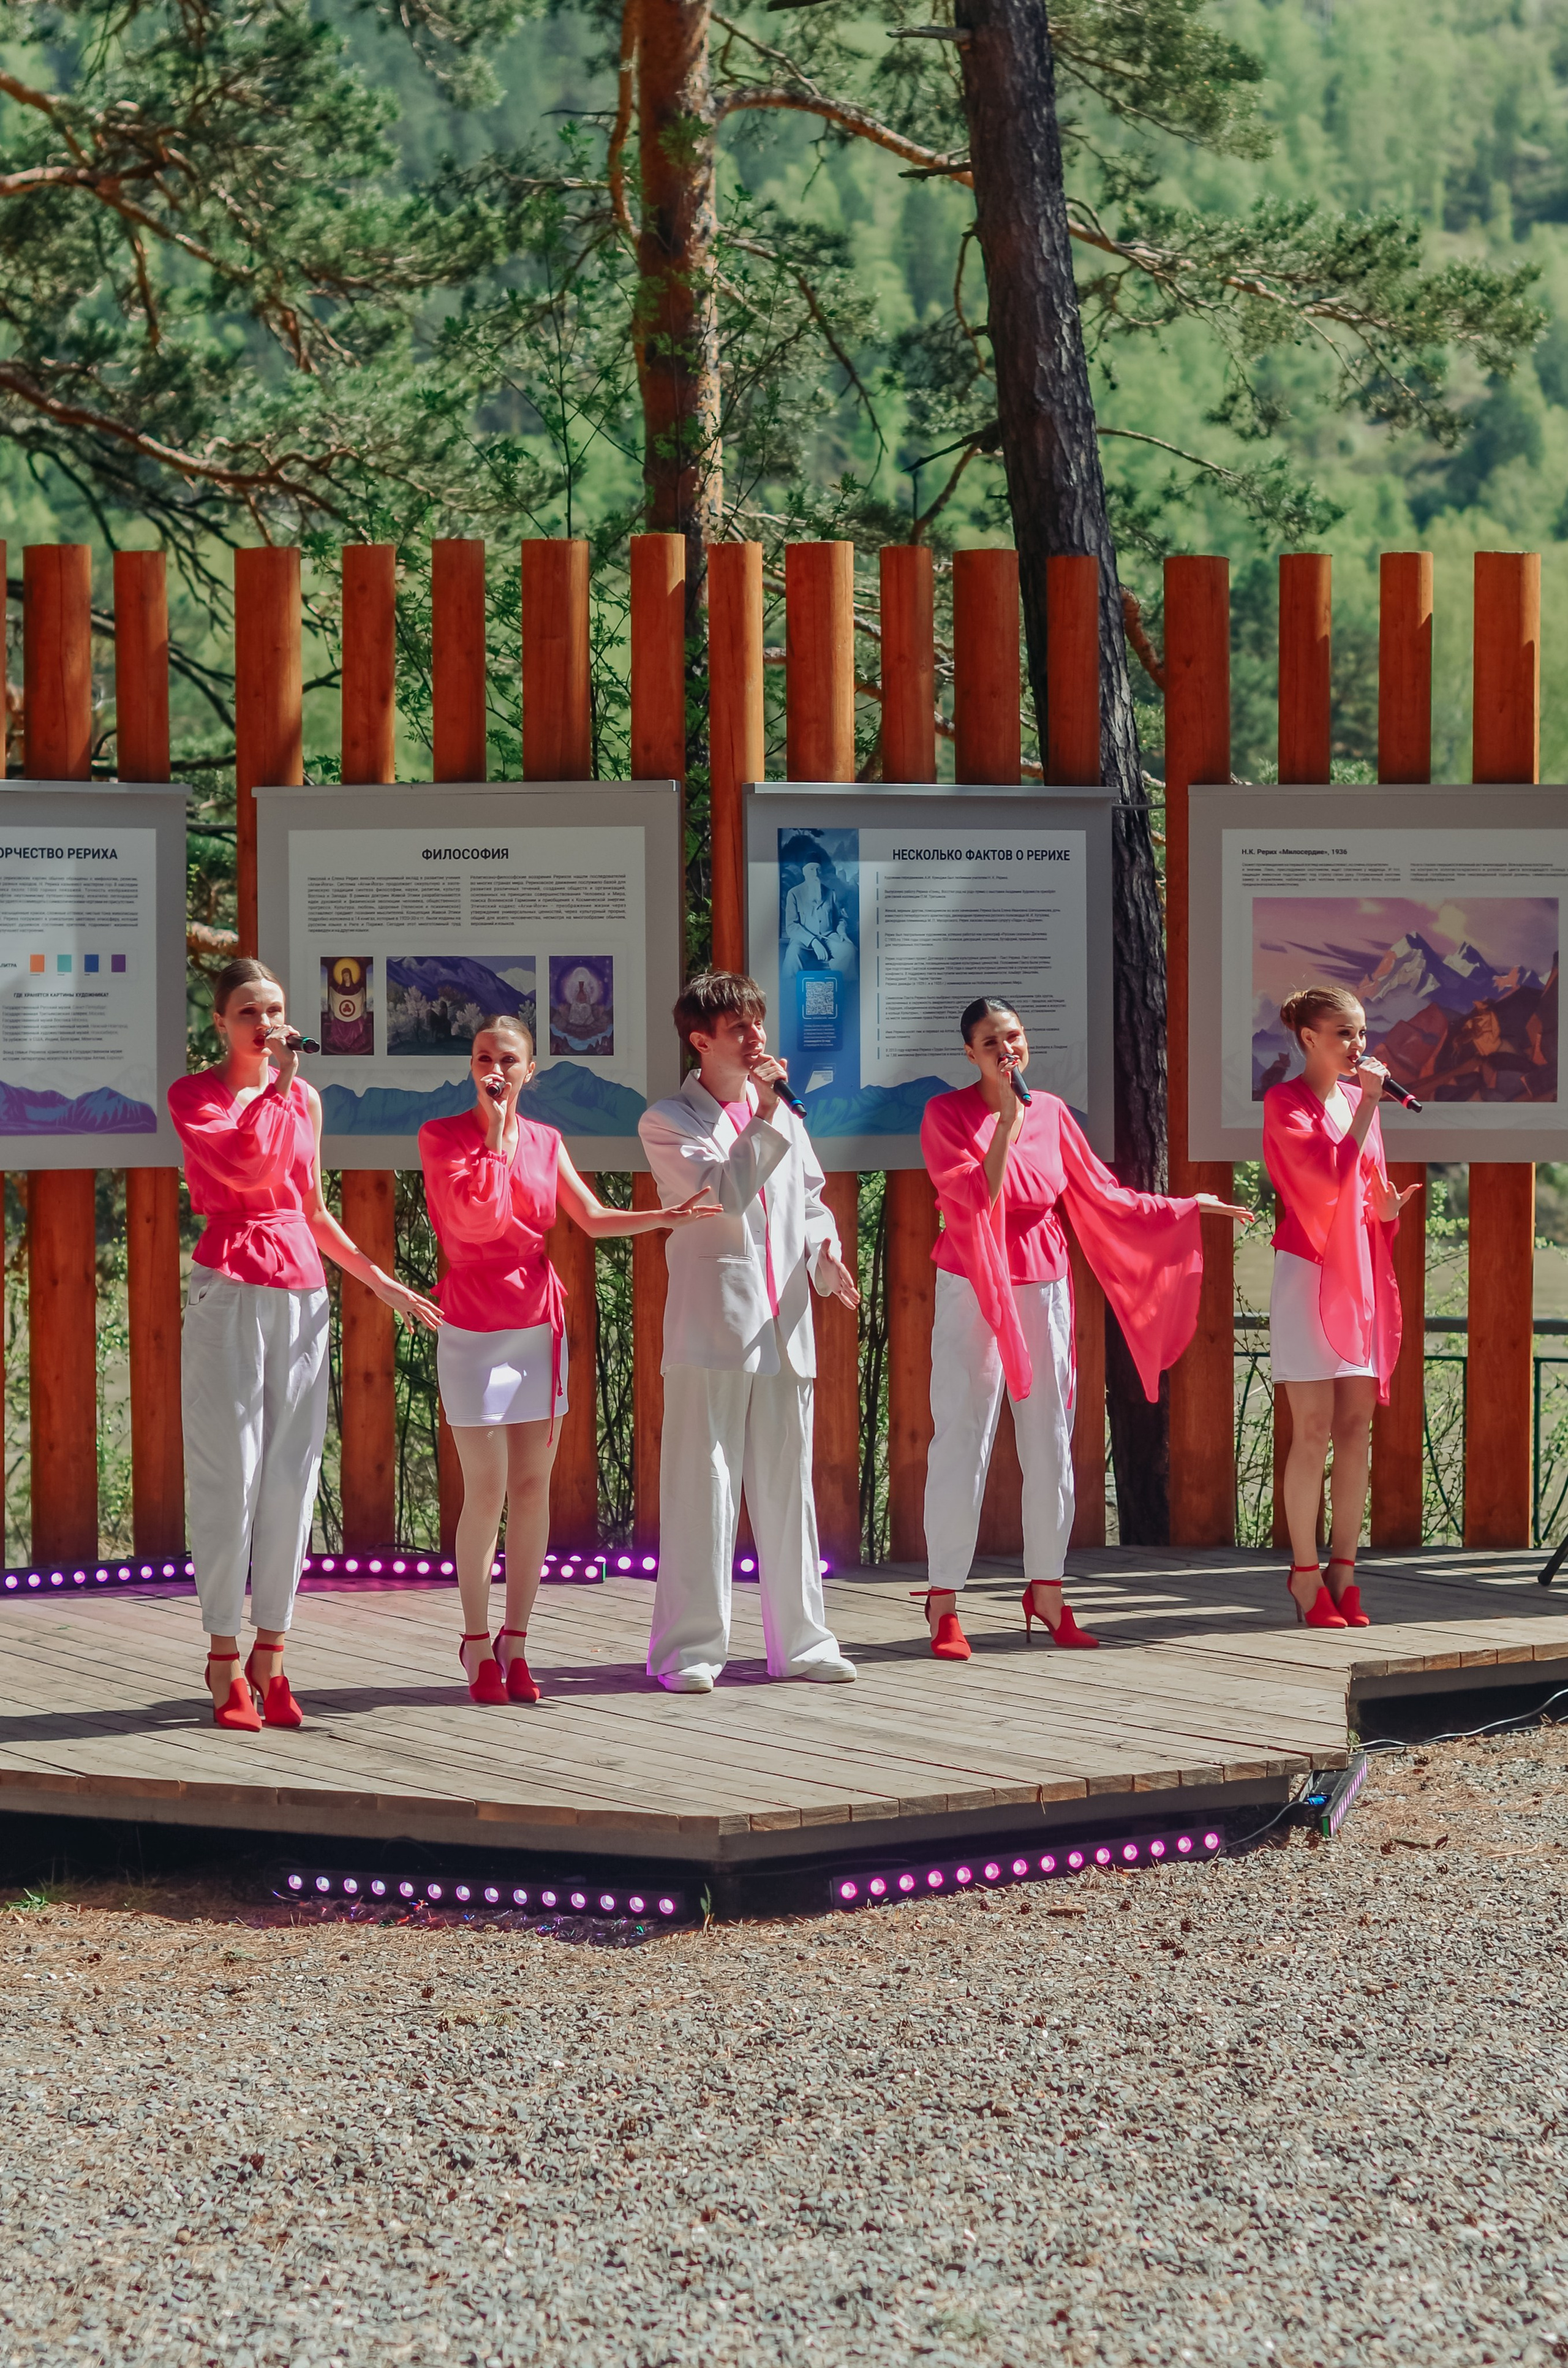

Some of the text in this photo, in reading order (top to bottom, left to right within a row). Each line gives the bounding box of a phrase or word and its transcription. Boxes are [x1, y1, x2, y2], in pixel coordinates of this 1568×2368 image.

[67, 848, 118, 860] РЕРИХА
[421, 848, 509, 861] ФИЛОСОФИЯ
[892, 849, 1071, 861] НЕСКОЛЬКО ФАКТОВ О РЕРИХЕ
